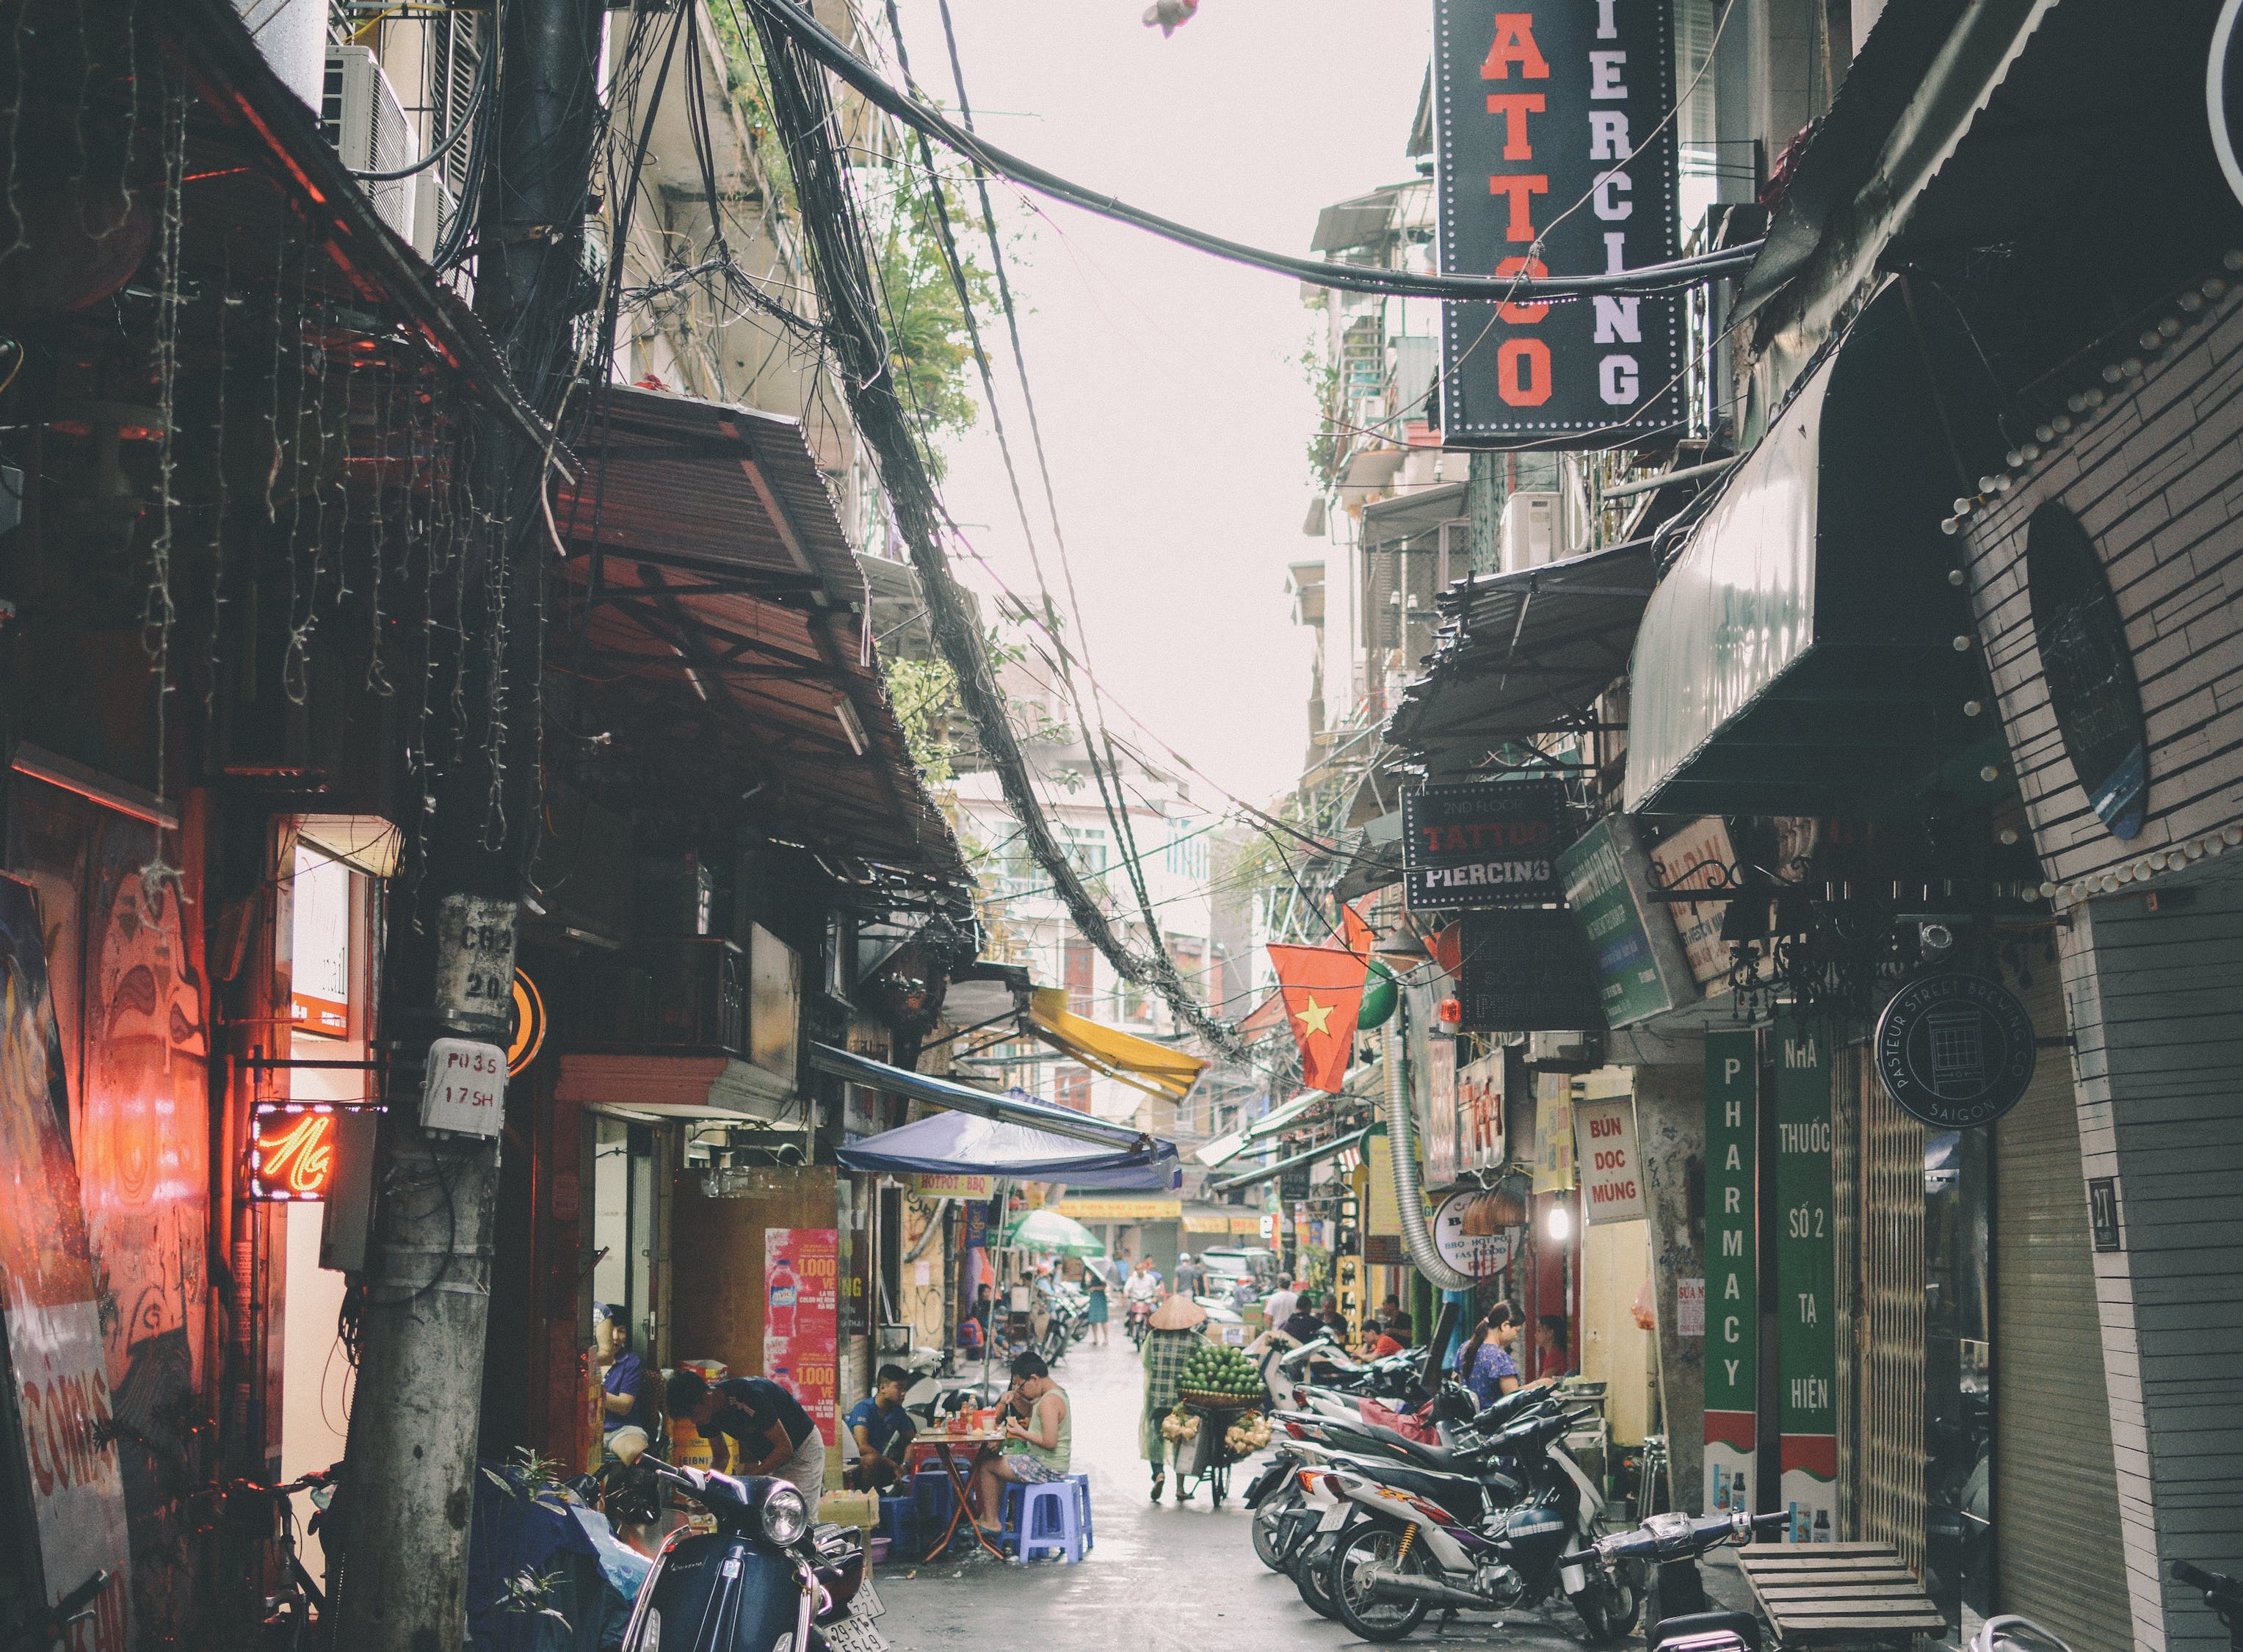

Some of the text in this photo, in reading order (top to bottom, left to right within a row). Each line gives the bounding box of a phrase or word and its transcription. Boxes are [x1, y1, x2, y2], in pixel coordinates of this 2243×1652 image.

[1423, 822, 1549, 852] TATTOO
[1426, 860, 1551, 888] PIERCING
[1886, 1015, 1909, 1088] PASTEUR
[1905, 980, 1957, 1012] STREET
[1969, 982, 2025, 1040] BREWING
[1785, 1033, 1817, 1068] NHÀ
[1929, 1098, 1996, 1121] SAIGON
[1590, 1114, 1622, 1138] BÚN
[1779, 1115, 1830, 1153] THUỐC
[1594, 1149, 1626, 1174] DỌC
[921, 1175, 985, 1193] HOTPOT BBQ
[1592, 1179, 1636, 1203] MÙNG
[1722, 1058, 1743, 1386] PHARMACY
[1789, 1200, 1824, 1238] SỐ 2
[798, 1258, 836, 1277] 1.000
[1799, 1294, 1816, 1327] TẠ
[797, 1367, 834, 1385] 1.000
[1791, 1374, 1827, 1413] HIỆN
